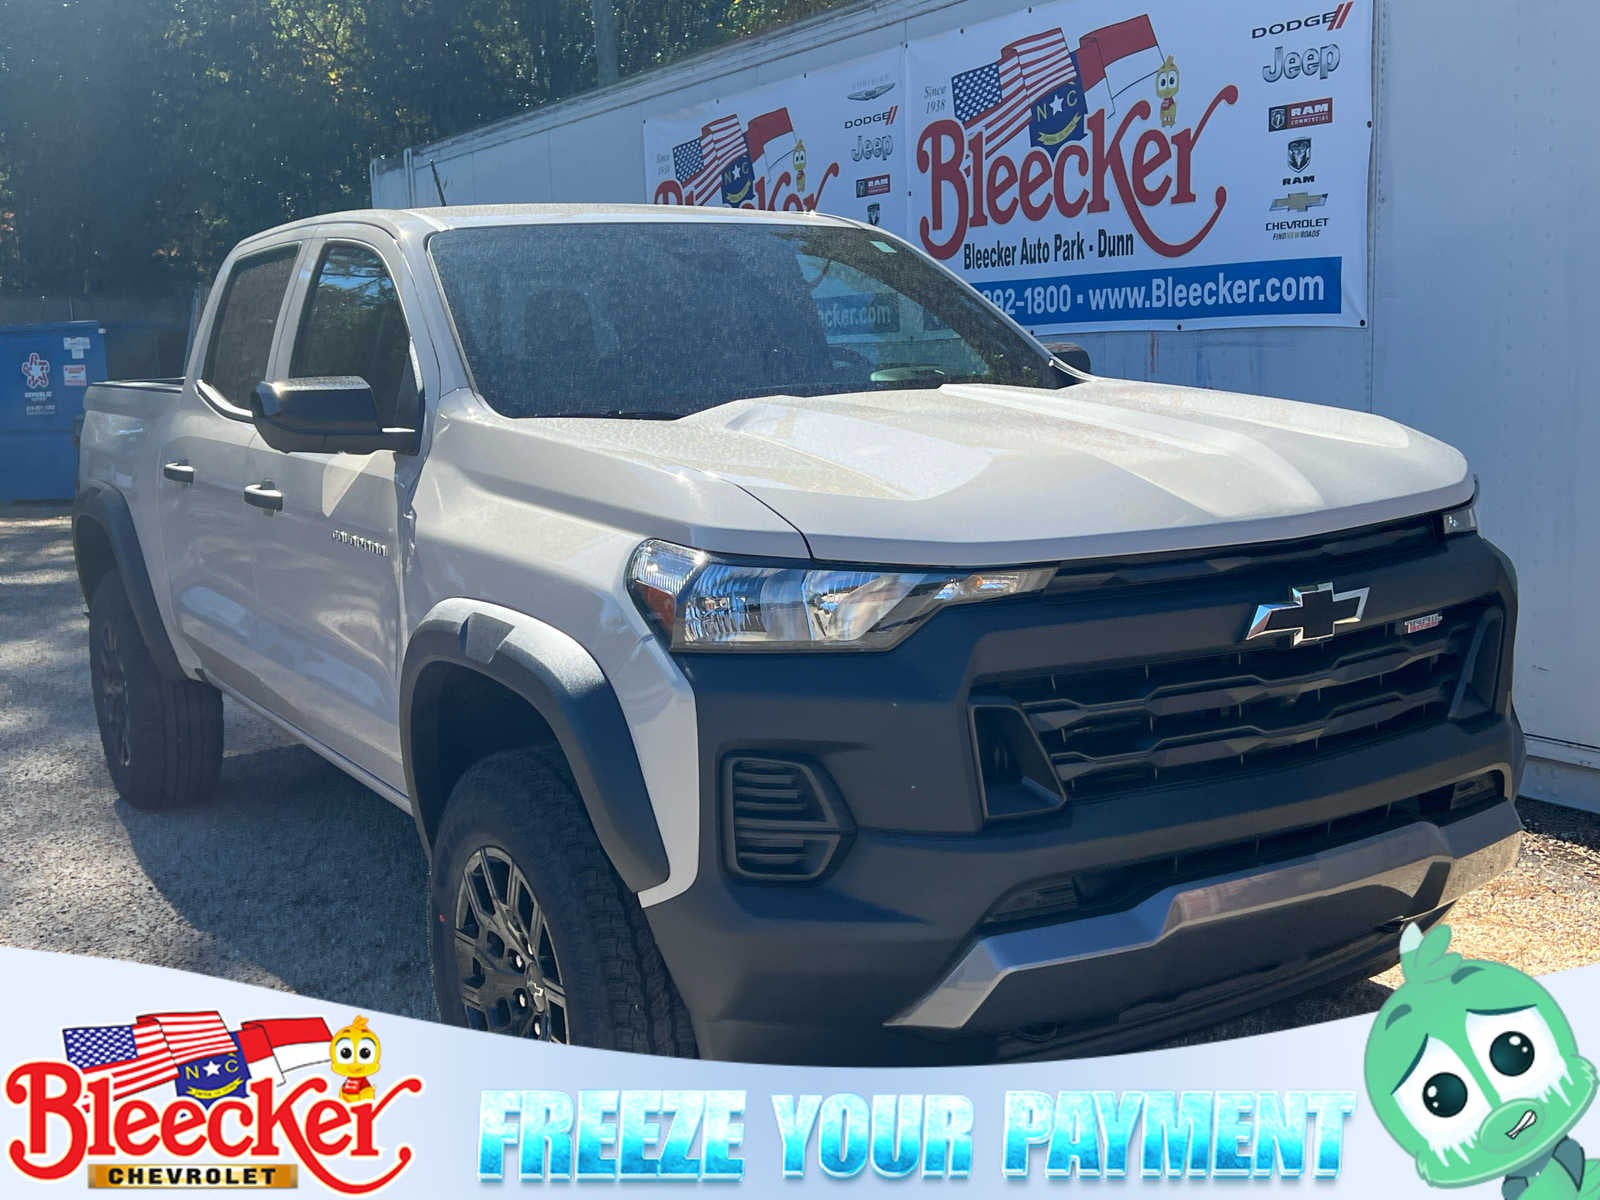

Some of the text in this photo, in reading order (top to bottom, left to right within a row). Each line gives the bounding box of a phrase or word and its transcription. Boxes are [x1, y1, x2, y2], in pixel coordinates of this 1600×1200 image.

[1252, 11, 1337, 39] DODGE
[1263, 43, 1340, 83] Jeep
[924, 86, 947, 98] Since
[926, 101, 945, 114] 1938
[1036, 90, 1078, 122] N C
[1291, 103, 1328, 117] RAM
[844, 112, 890, 129] DODGE
[851, 135, 893, 162] Jeep
[917, 85, 1239, 260] Bleecker
[1282, 175, 1315, 186] RAM
[1265, 217, 1329, 231] CHEVROLET
[964, 229, 1134, 270] Bleecker Auto Park Dunn
[1089, 272, 1325, 310] www.Bleecker.com
